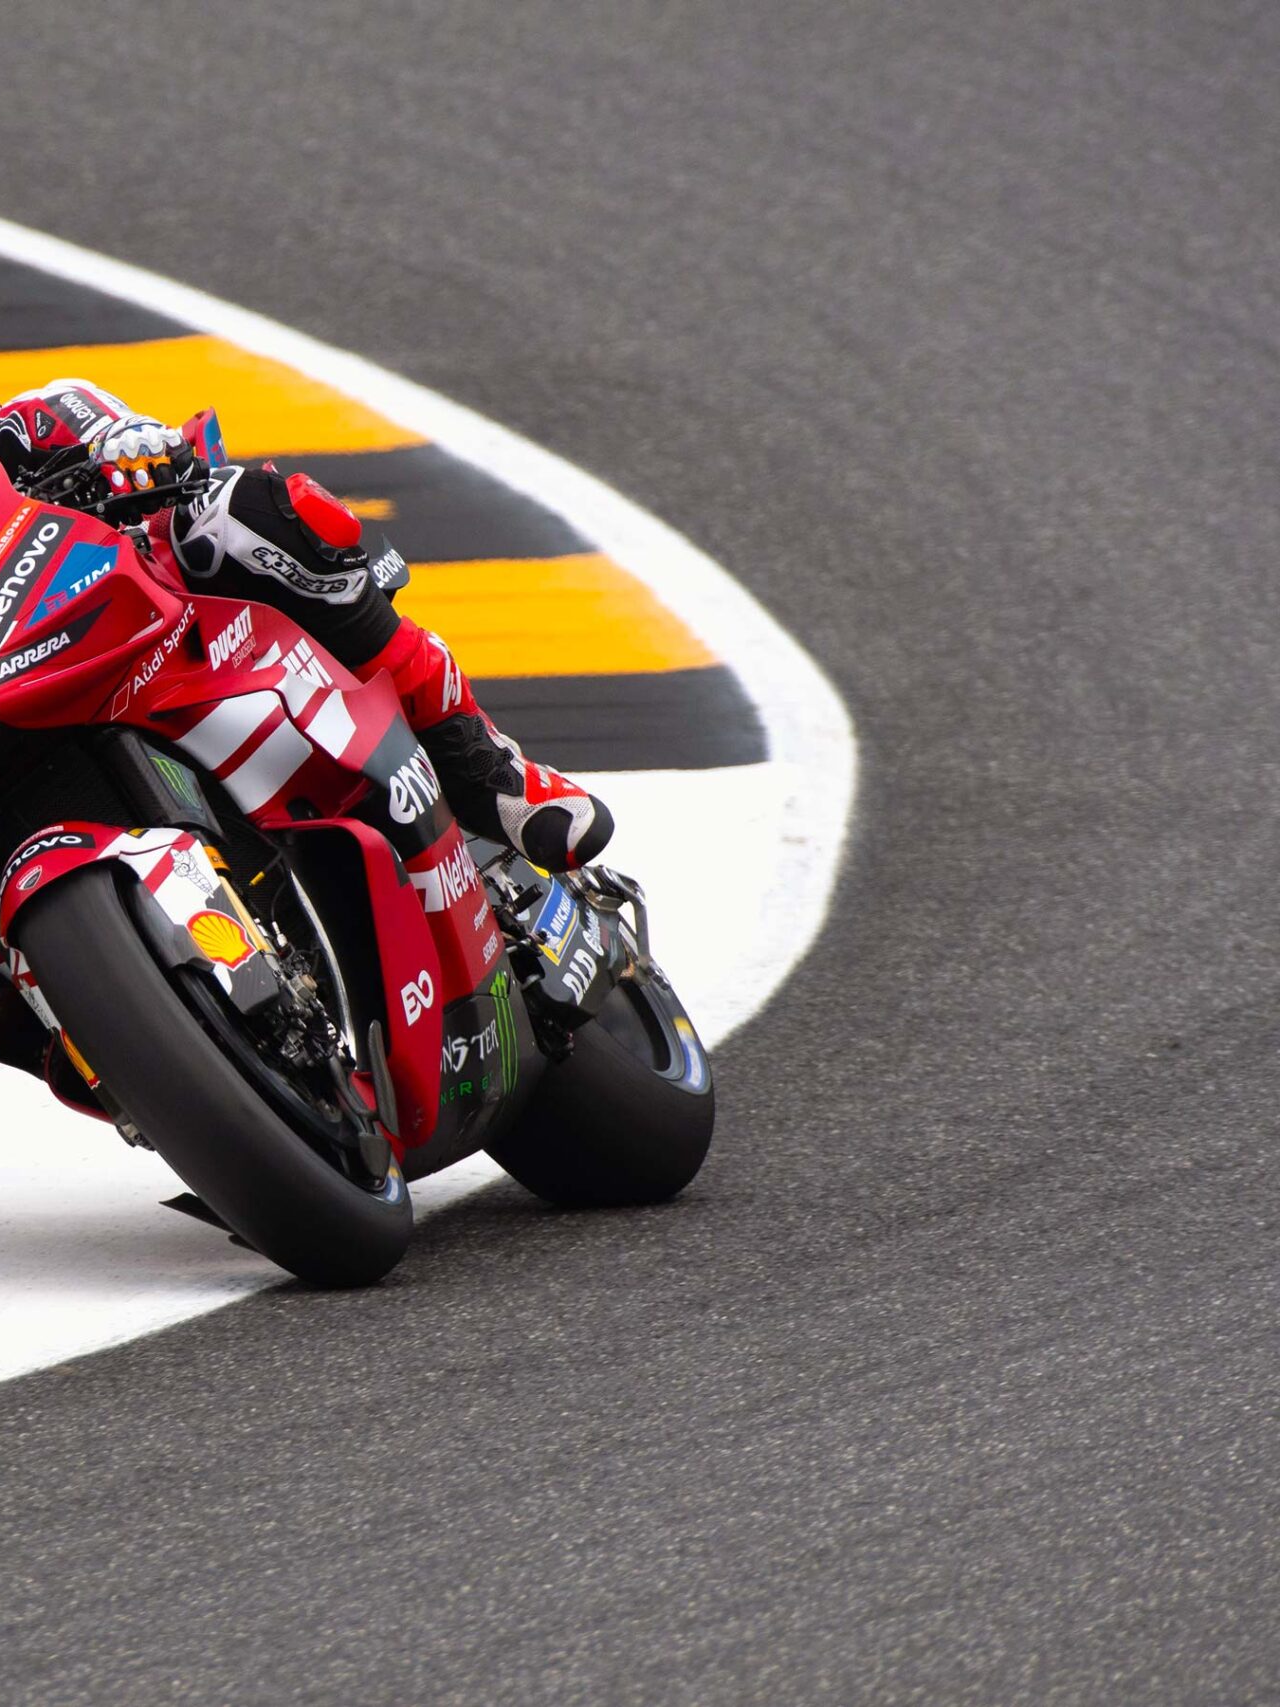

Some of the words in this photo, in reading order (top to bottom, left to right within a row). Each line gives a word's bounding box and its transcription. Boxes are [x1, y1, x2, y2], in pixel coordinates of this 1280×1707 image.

[60, 393, 97, 429] Lenovo
[69, 561, 111, 595] TIM
[252, 546, 350, 594] alpinestars
[132, 649, 165, 695] Audi
[163, 601, 196, 656] Sport
[207, 605, 254, 673] DUCATI
[440, 1018, 500, 1075] NSTER
